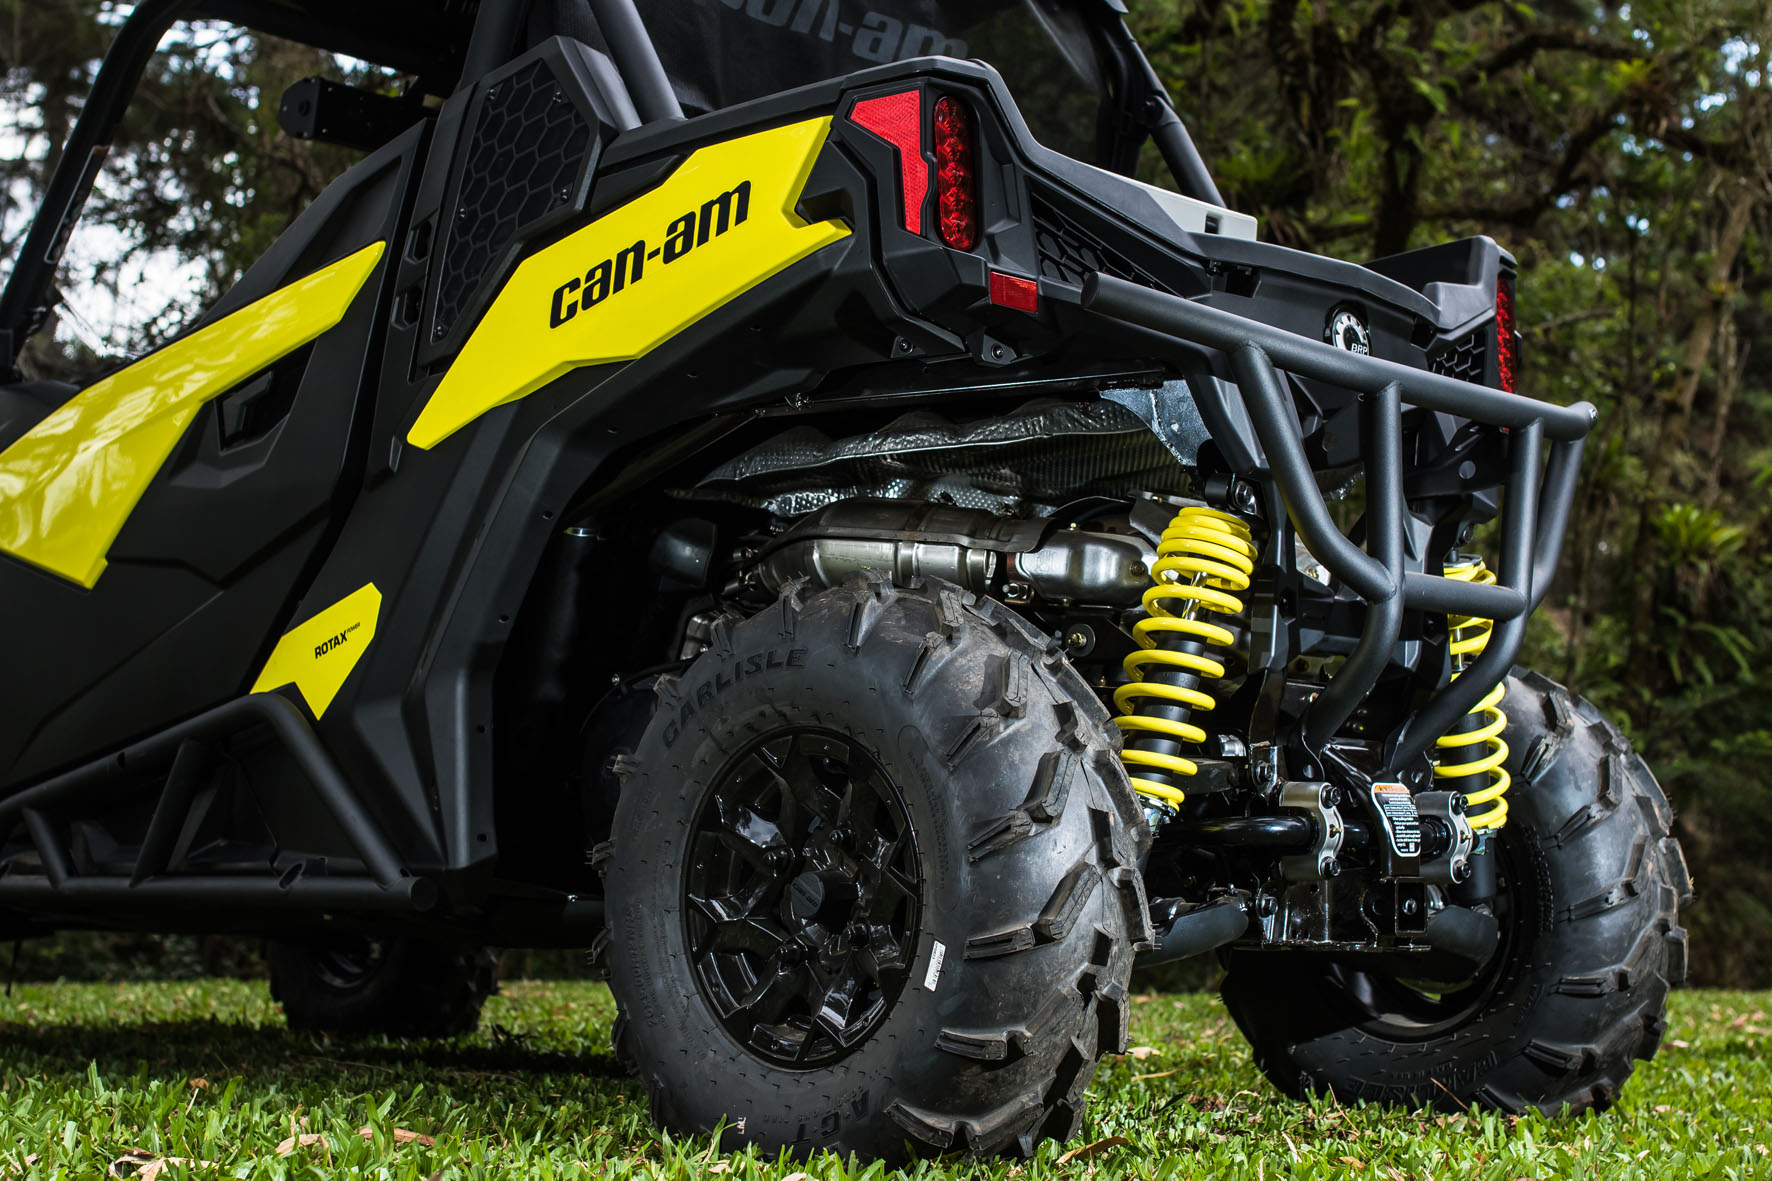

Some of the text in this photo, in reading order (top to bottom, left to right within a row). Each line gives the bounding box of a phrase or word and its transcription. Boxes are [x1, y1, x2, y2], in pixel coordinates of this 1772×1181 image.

[550, 180, 751, 329] can-am
[1350, 343, 1368, 355] BRP
[314, 630, 348, 659] ROTAX
[662, 647, 809, 749] CARLISLE
